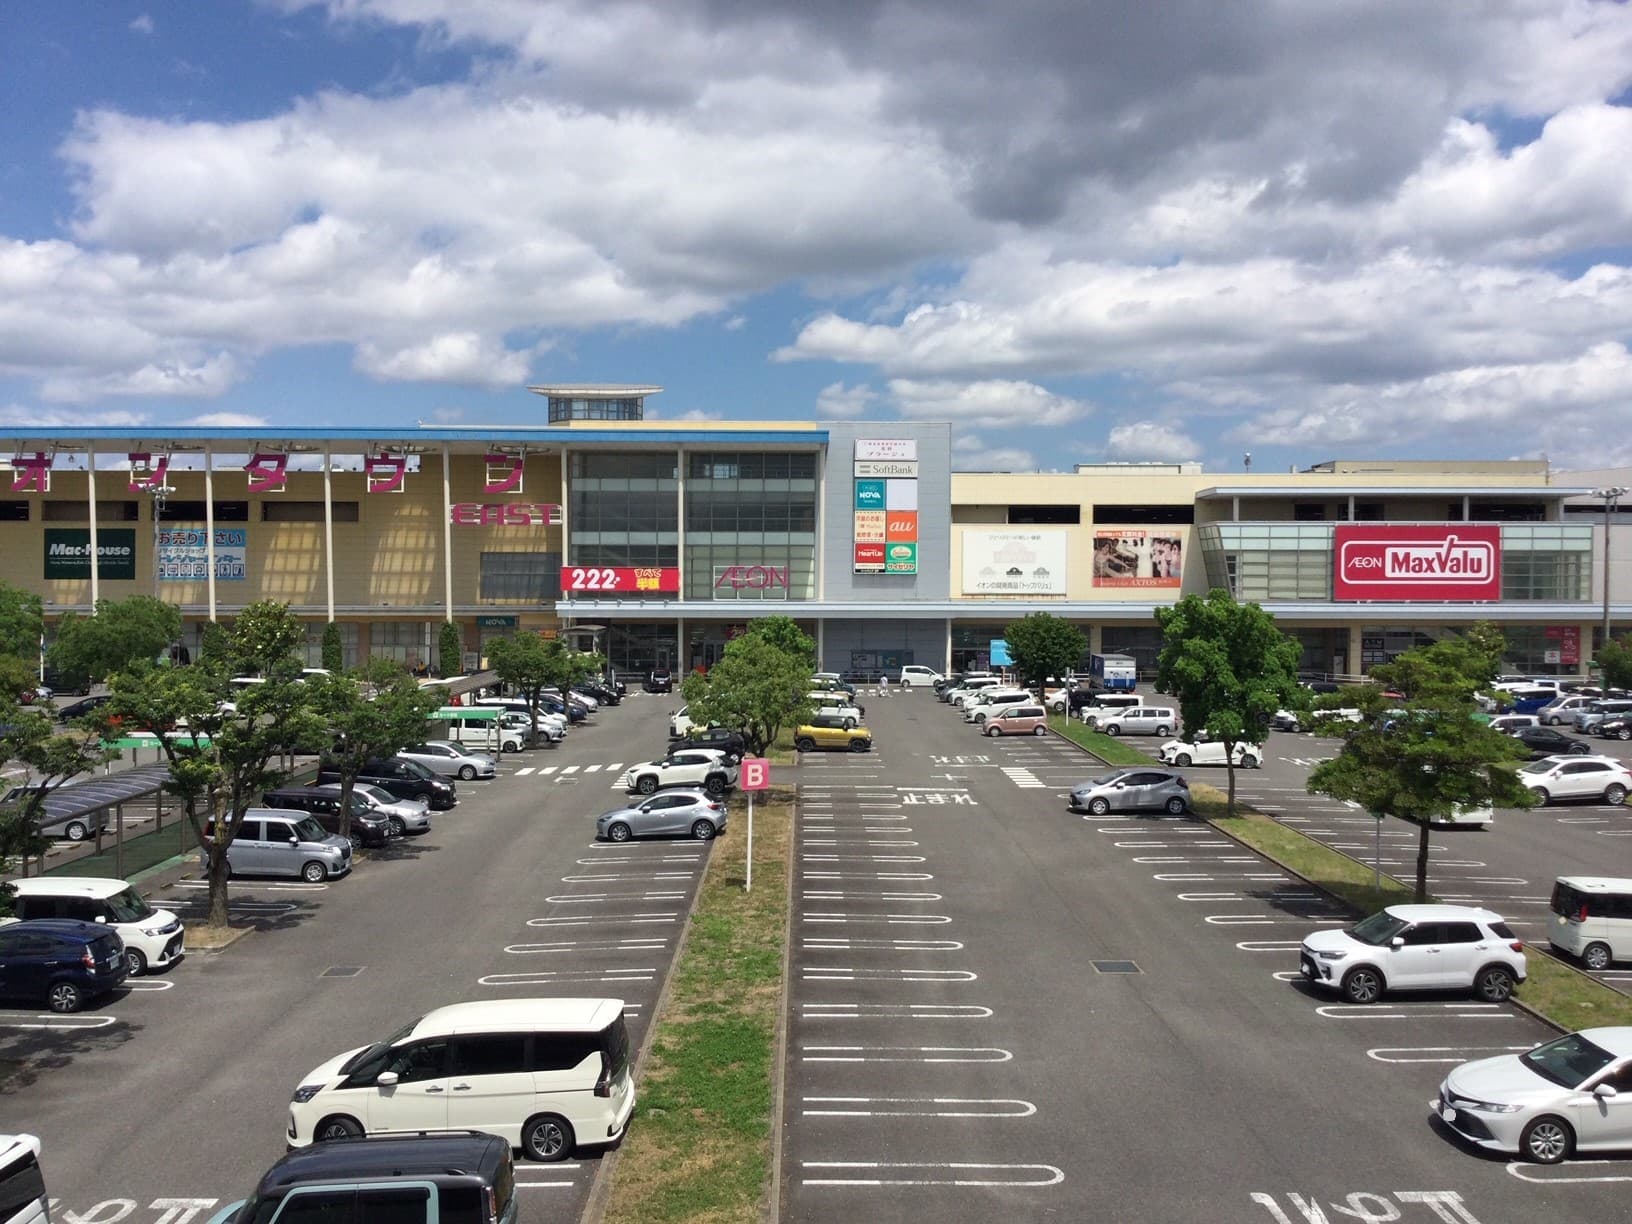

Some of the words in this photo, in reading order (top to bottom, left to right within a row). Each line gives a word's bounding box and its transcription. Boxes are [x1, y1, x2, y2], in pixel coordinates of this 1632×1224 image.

[872, 464, 913, 474] SoftBank
[859, 491, 881, 499] NOVA
[452, 503, 560, 526] EAST
[889, 521, 915, 532] au
[1391, 537, 1482, 574] MaxValu
[747, 764, 763, 786] B
[903, 793, 978, 805] 止まれ
